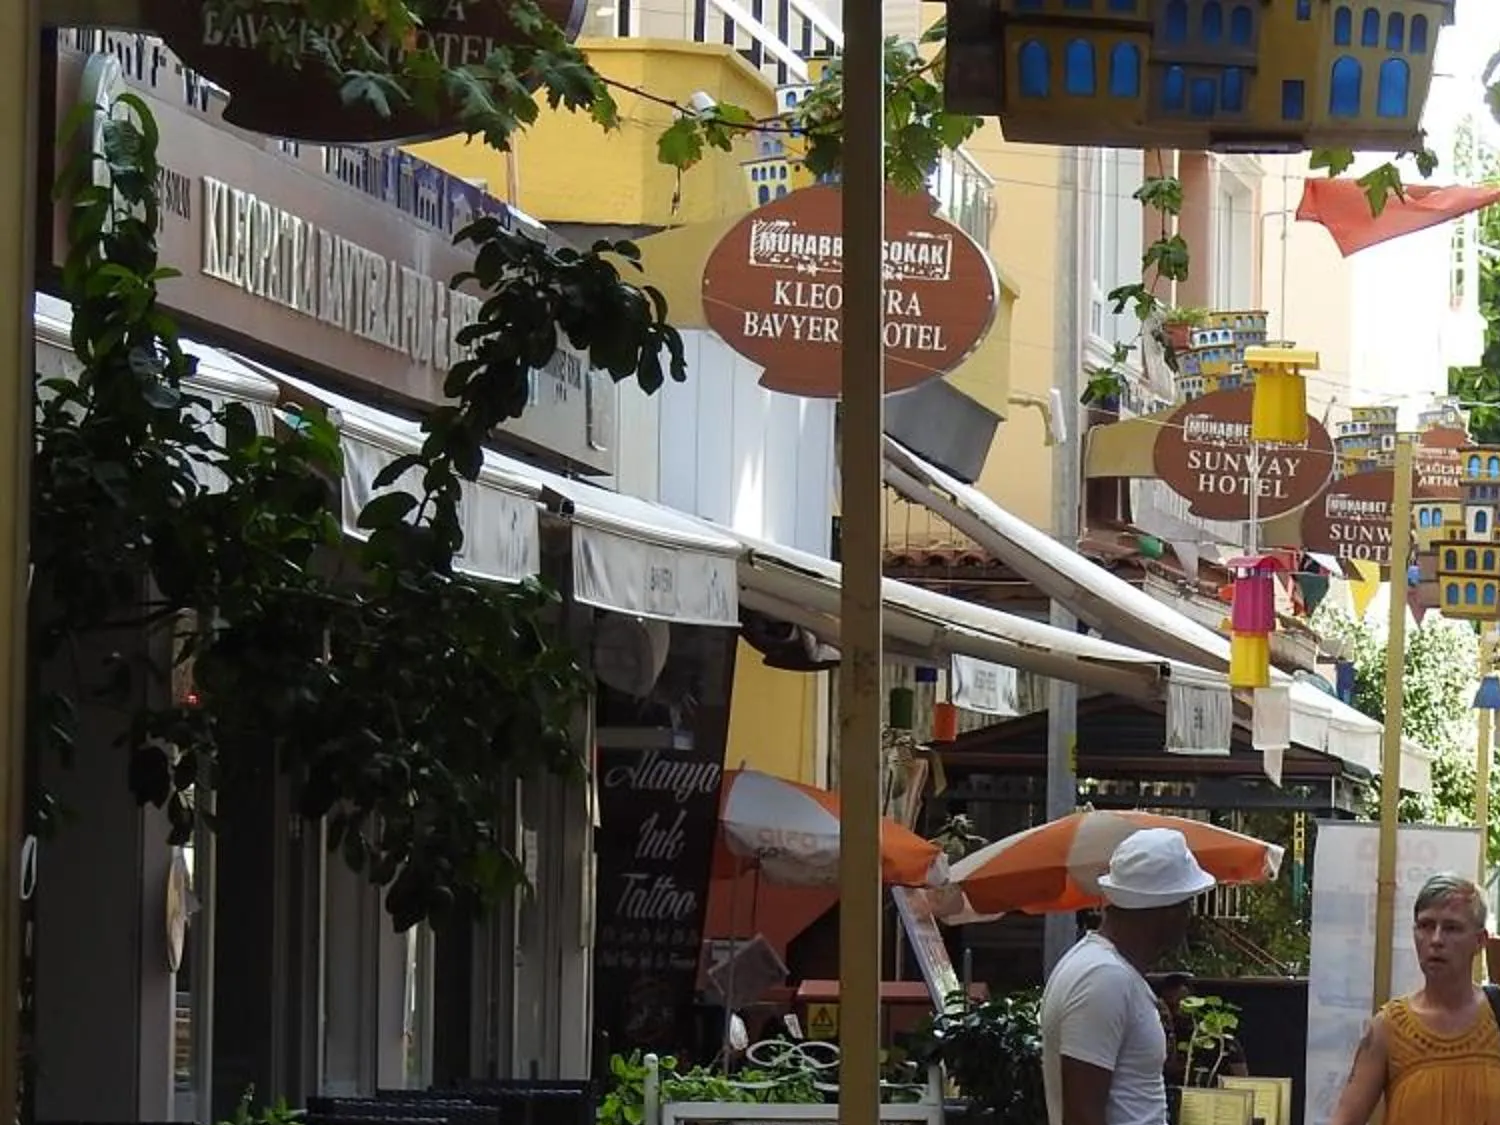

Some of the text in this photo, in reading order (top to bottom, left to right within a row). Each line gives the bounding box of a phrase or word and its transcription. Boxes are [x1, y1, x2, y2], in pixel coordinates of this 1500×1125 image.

[202, 175, 318, 318] KLEOPATRA
[758, 230, 842, 257] MUHABB
[774, 280, 922, 317] KLEORA
[743, 311, 947, 351] BAVYER OTEL
[1188, 419, 1250, 437] MUHABBE
[1187, 450, 1301, 477] SUNWAY
[1199, 473, 1288, 499] HOTEL
[1329, 523, 1392, 543] SUNW
[1338, 543, 1393, 562] HOT
[605, 750, 721, 805] Alanya
[634, 809, 688, 862] Ink
[616, 872, 698, 920] Tattoo
